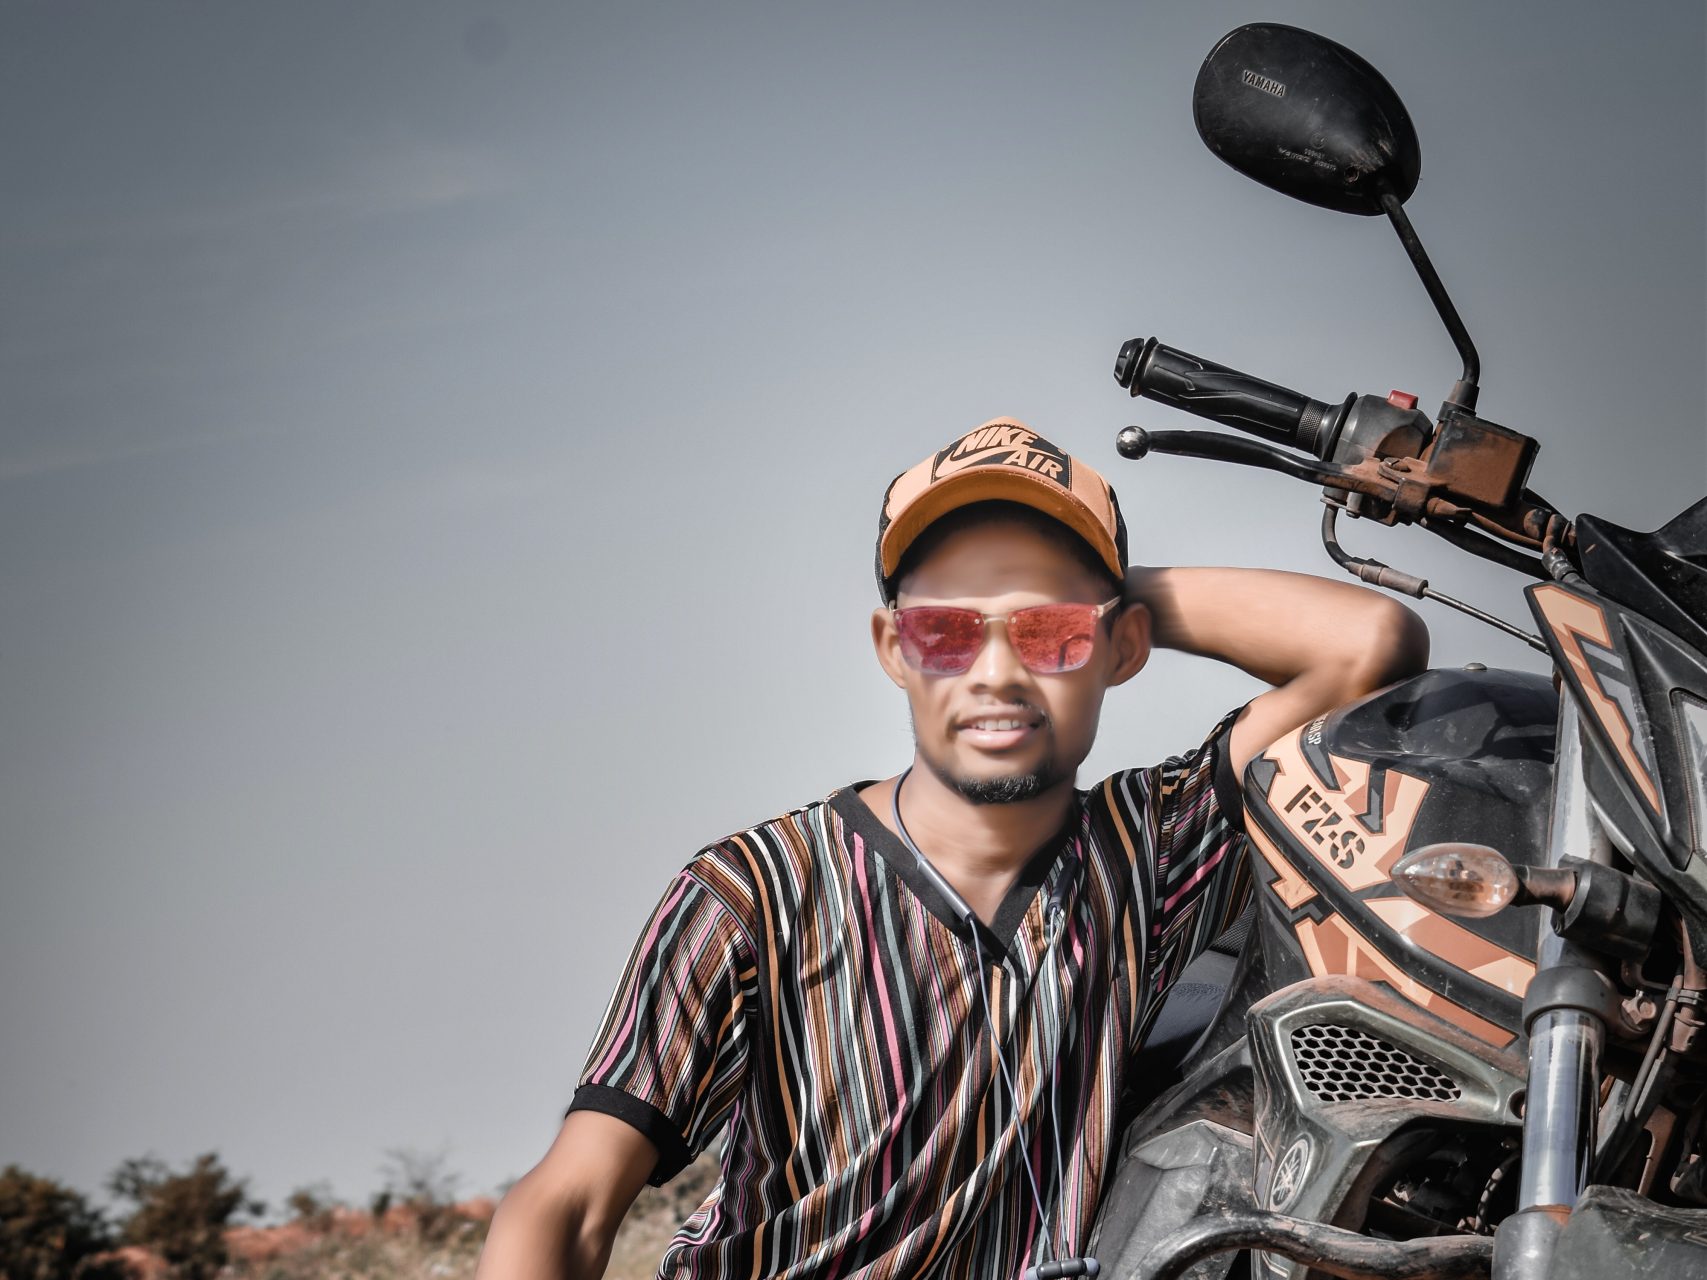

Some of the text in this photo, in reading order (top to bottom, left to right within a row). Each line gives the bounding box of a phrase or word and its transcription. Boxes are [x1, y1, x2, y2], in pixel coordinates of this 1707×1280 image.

[1243, 70, 1285, 97] YAMAHA
[952, 426, 1039, 458] NIKE
[1002, 446, 1063, 479] AIR
